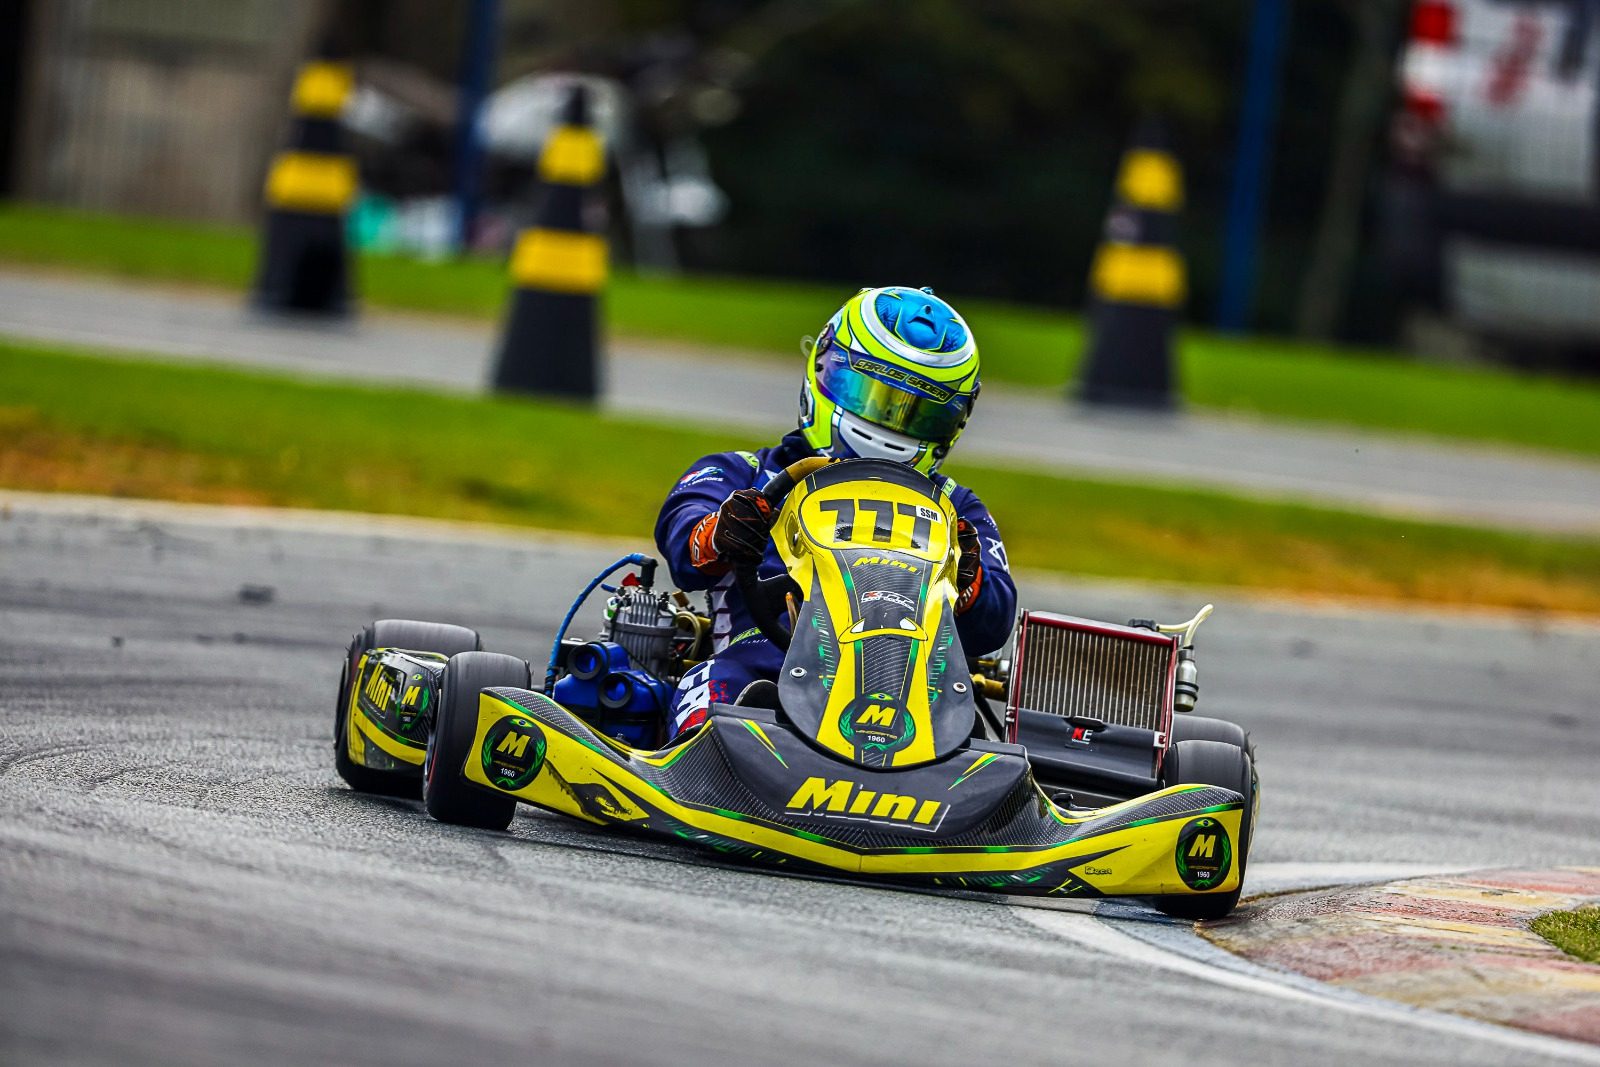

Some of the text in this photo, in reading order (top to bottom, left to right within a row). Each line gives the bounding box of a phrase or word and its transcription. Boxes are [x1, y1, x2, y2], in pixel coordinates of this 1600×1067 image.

[819, 499, 932, 553] 777
[920, 507, 938, 521] SSM
[856, 704, 896, 727] M
[496, 731, 531, 758] M
[867, 735, 886, 743] 1960
[785, 776, 942, 826] Mini
[1188, 834, 1216, 858] M
